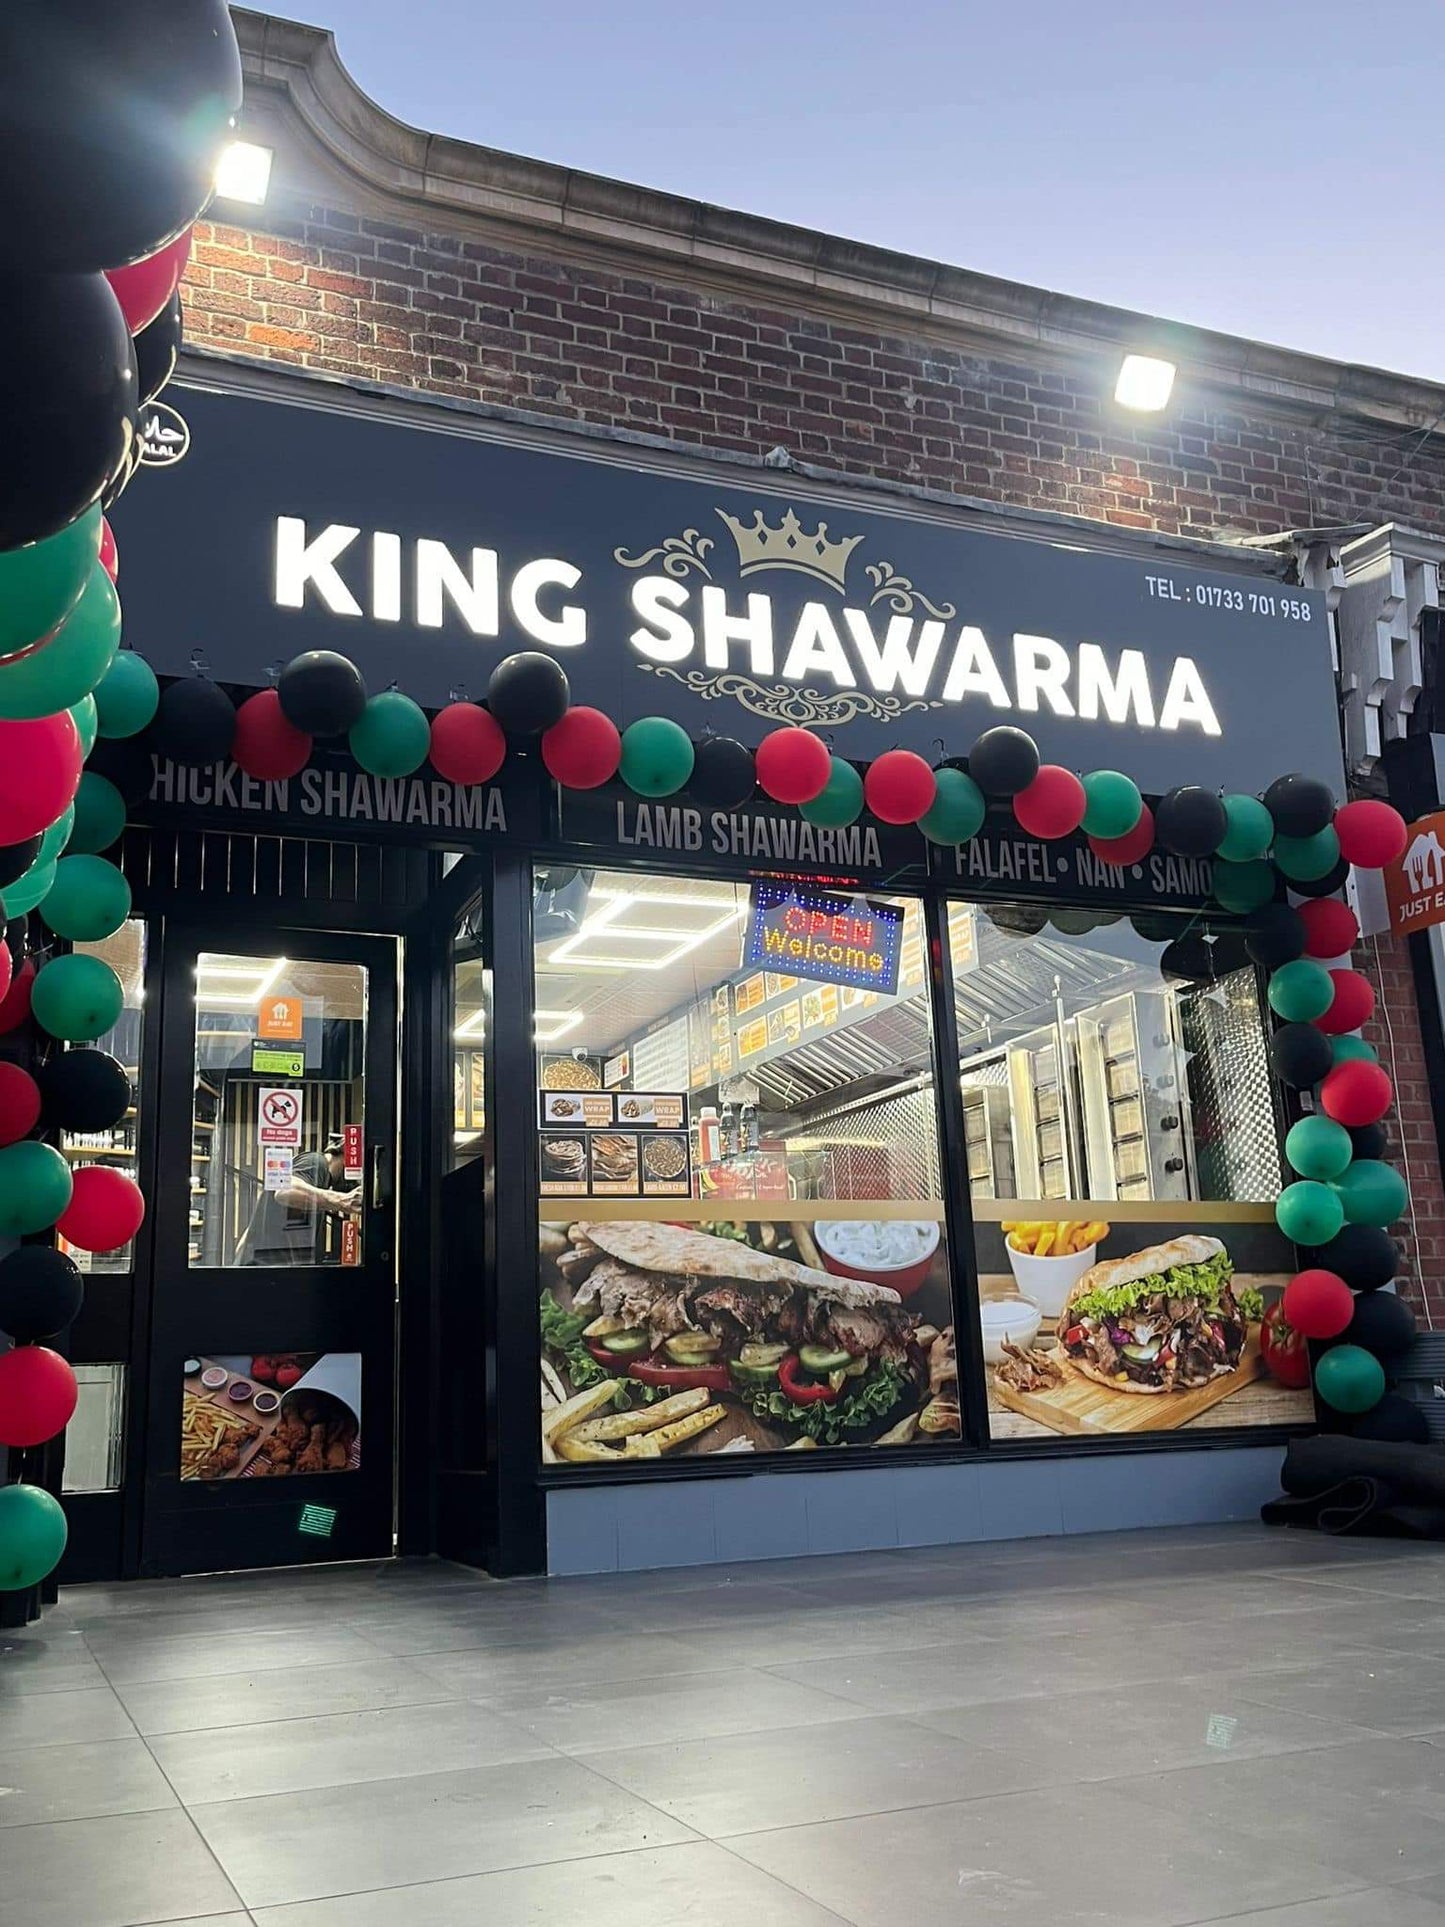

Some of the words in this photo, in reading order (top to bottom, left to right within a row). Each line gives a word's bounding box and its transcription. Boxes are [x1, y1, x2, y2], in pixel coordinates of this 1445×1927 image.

[143, 442, 177, 457] ALAL
[1145, 575, 1182, 601] TEL
[1196, 585, 1244, 611] 01733
[1249, 594, 1276, 617] 701
[1280, 599, 1311, 622] 958
[275, 515, 587, 646] KING
[629, 576, 1223, 736] SHAWARMA
[150, 753, 289, 813] HICKEN
[300, 768, 508, 832] SHAWARMA
[616, 800, 703, 851] LAMB
[711, 811, 882, 868] SHAWARMA
[954, 837, 1057, 884] FALAFEL
[1076, 847, 1126, 889] NAN
[1151, 853, 1216, 897] SAMO
[785, 906, 873, 946] OPEN
[1399, 895, 1432, 923] JUST
[1434, 890, 1445, 909] E
[763, 925, 884, 971] Welcome
[349, 1126, 358, 1166] PUSH
[346, 1222, 354, 1252] PUSH
